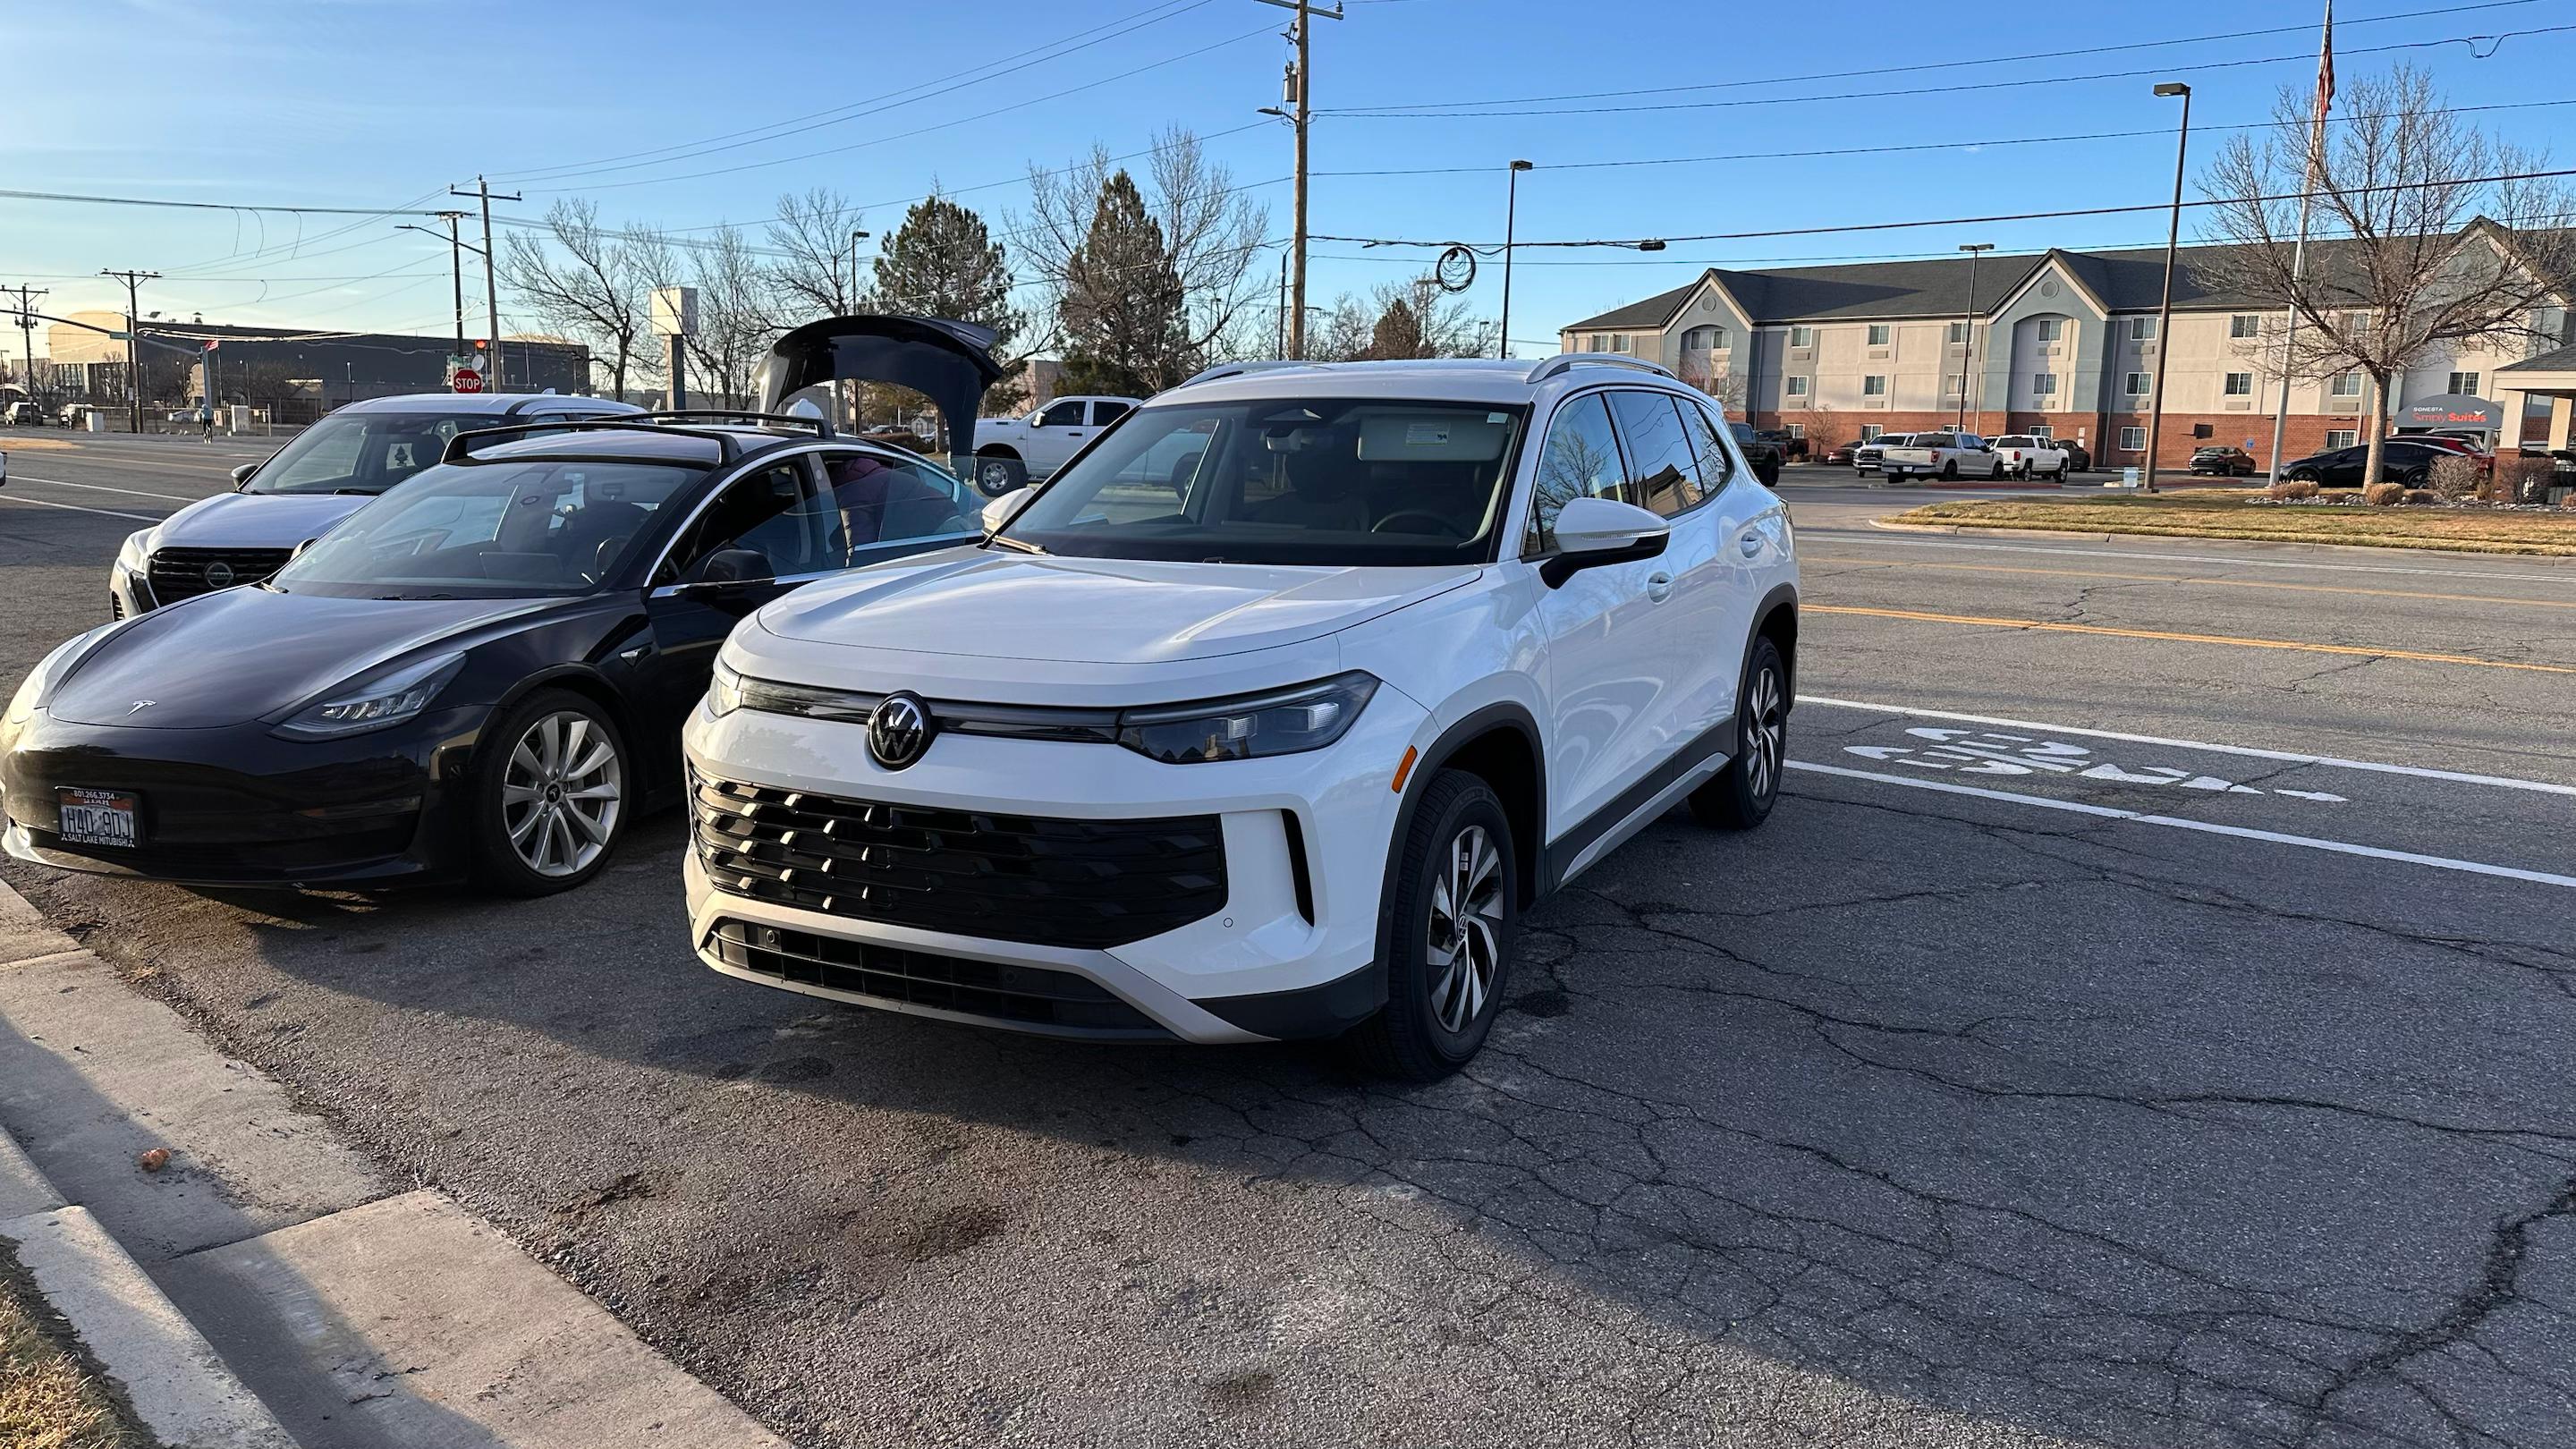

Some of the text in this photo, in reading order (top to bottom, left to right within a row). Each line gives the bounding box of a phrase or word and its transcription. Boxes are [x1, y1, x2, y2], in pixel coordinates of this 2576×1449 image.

[455, 377, 480, 390] STOP
[2412, 412, 2487, 424] Simply Suites
[73, 790, 115, 801] 801.266.3734
[68, 834, 82, 843] SALT
[83, 835, 98, 844] LAKE
